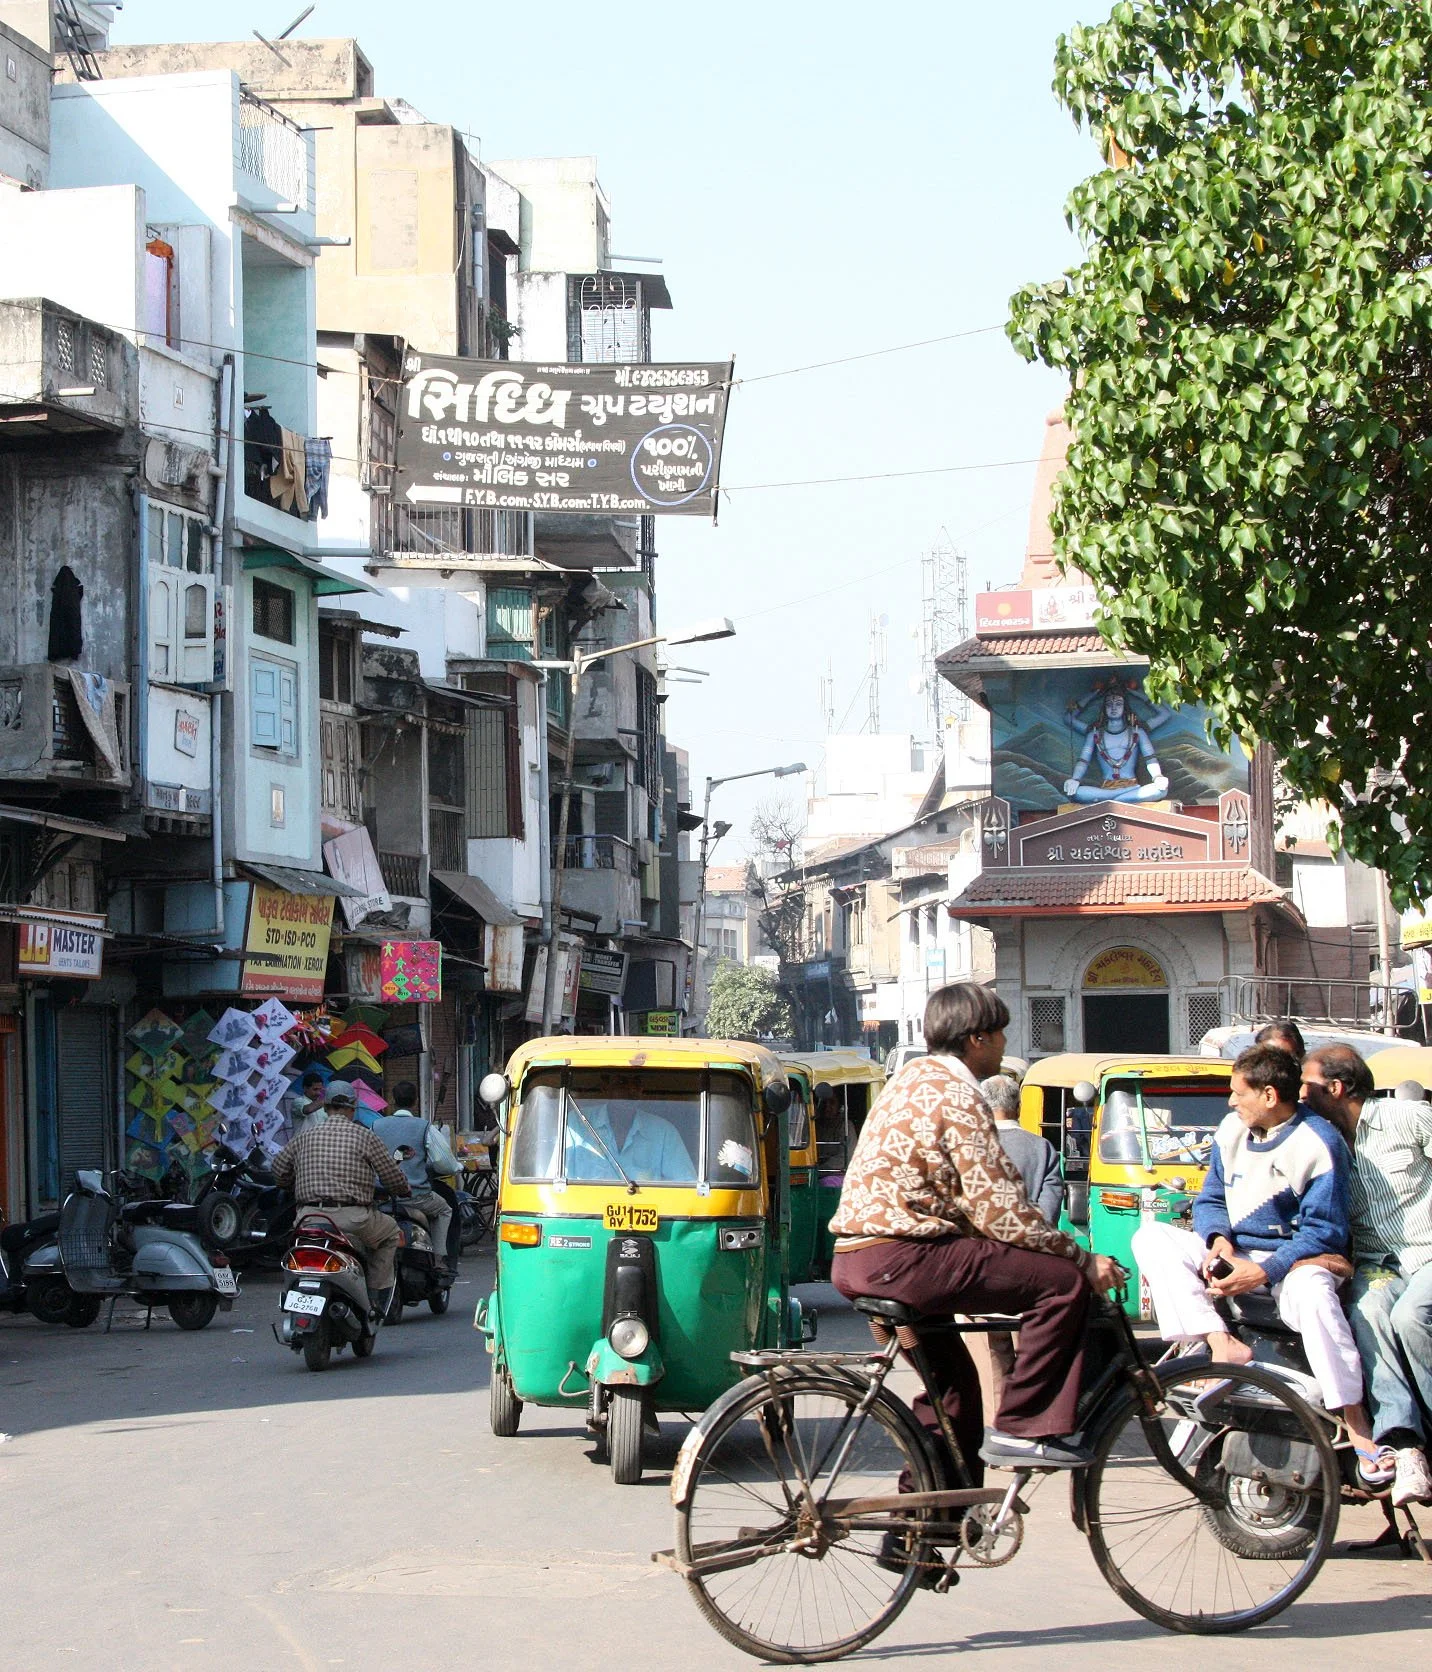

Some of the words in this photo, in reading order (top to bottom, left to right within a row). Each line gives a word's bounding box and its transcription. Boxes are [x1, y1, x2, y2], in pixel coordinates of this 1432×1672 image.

[644, 436, 698, 460] ૧૦૦%
[535, 472, 570, 488] સર
[1047, 844, 1064, 861] શ્રી
[1136, 840, 1184, 862] મહાદેવ
[52, 928, 96, 954] MASTER
[266, 928, 281, 944] STD
[284, 930, 297, 946] ISD
[300, 932, 316, 948] PCO
[304, 956, 324, 972] XEROX
[606, 1205, 620, 1216] GJ
[627, 1206, 656, 1226] 1752
[610, 1218, 624, 1228] AV
[550, 1237, 562, 1246] RE
